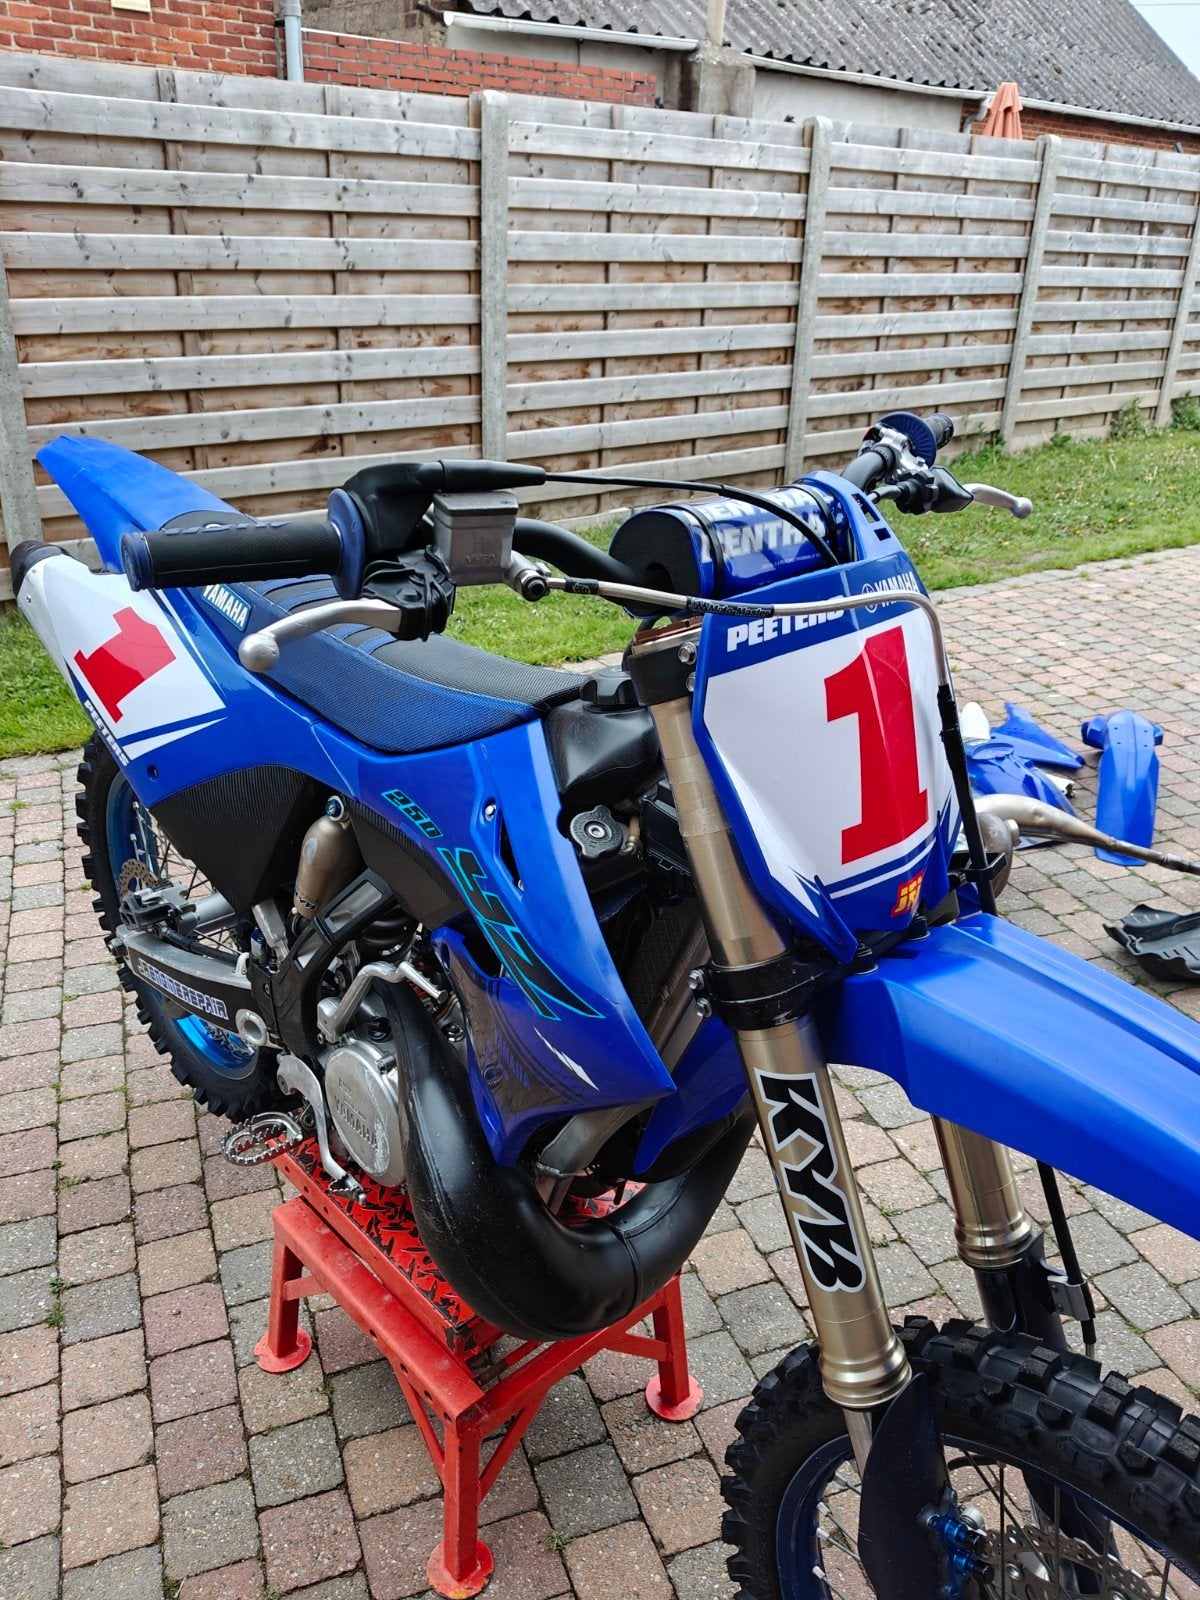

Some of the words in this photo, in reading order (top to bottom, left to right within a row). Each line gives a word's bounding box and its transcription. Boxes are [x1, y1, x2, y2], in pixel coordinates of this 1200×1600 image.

[203, 583, 248, 628] YAMAHA
[73, 606, 177, 724] 1
[83, 699, 130, 767] PEETERS
[823, 625, 929, 866] 1
[380, 788, 444, 839] 250
[753, 1067, 867, 1293] KYB
